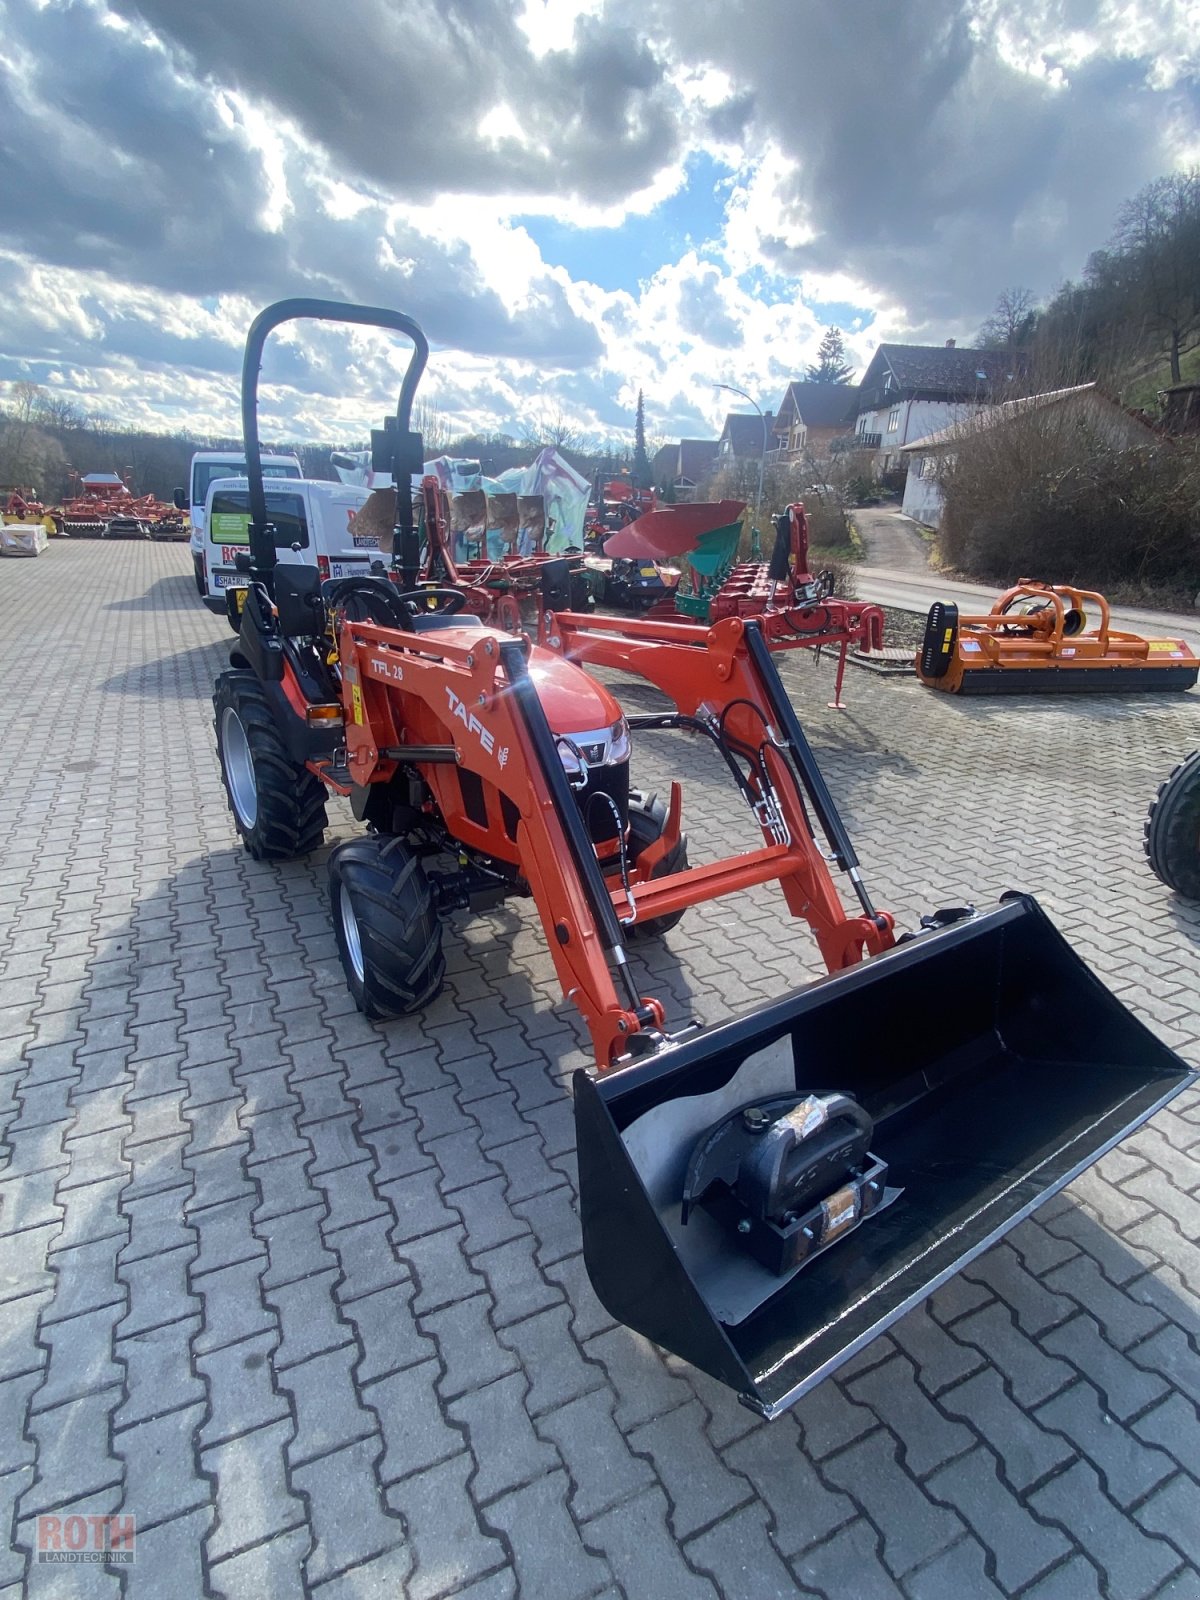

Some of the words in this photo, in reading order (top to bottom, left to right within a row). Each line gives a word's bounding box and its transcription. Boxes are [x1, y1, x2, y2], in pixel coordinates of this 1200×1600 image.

[371, 659, 391, 677] TFL
[392, 664, 403, 681] 28
[445, 685, 495, 756] TAFE
